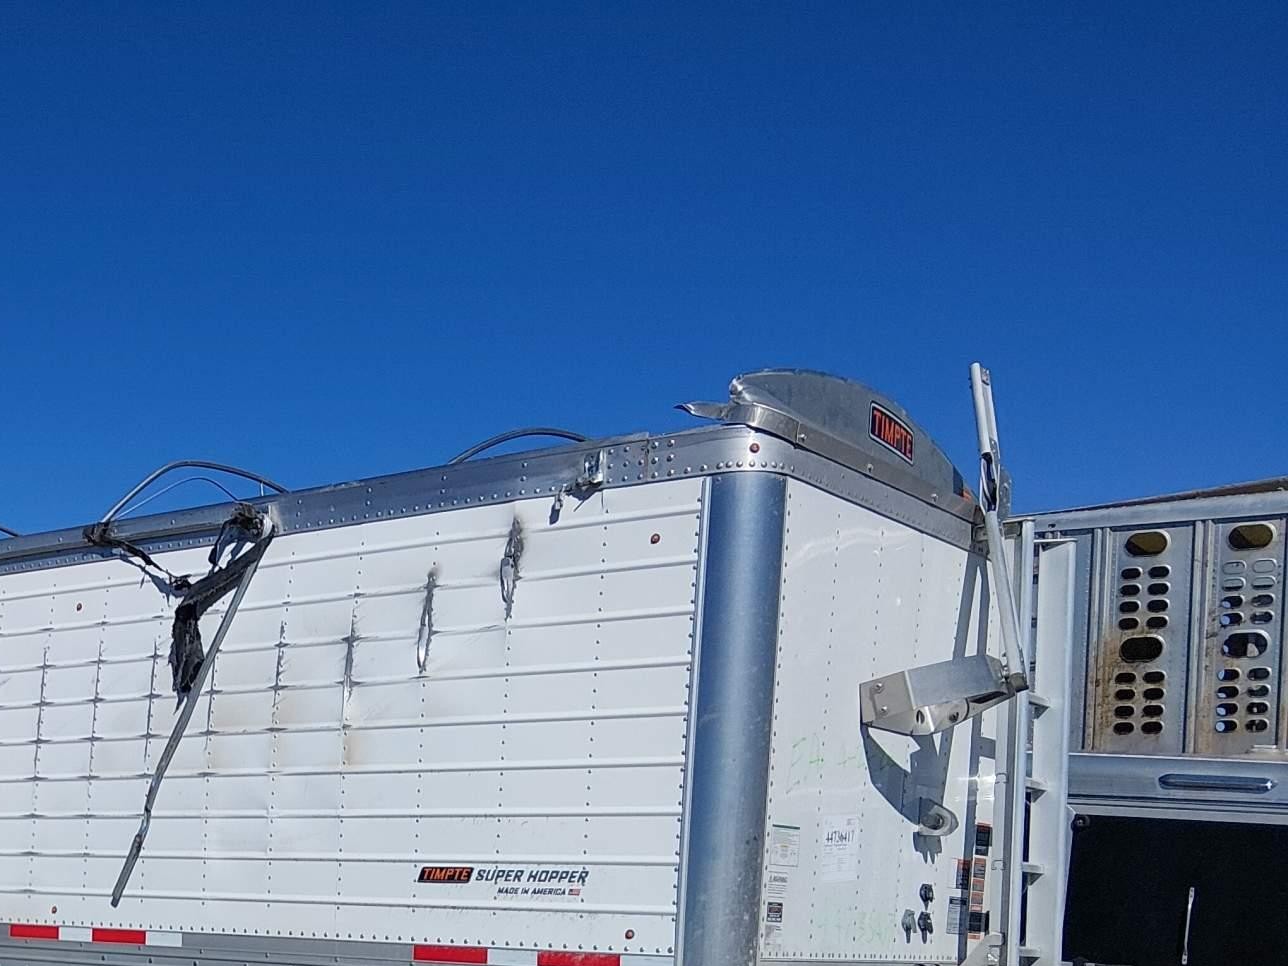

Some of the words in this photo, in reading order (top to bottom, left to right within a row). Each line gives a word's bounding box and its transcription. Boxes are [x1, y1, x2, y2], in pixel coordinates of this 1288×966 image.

[873, 409, 912, 459] TIMPTE
[423, 868, 472, 880] TIMPTE
[475, 869, 525, 883] SUPER
[527, 870, 589, 884] HOPPER
[497, 887, 520, 895] MADE
[521, 887, 530, 895] IN
[531, 887, 566, 896] AMERICA
